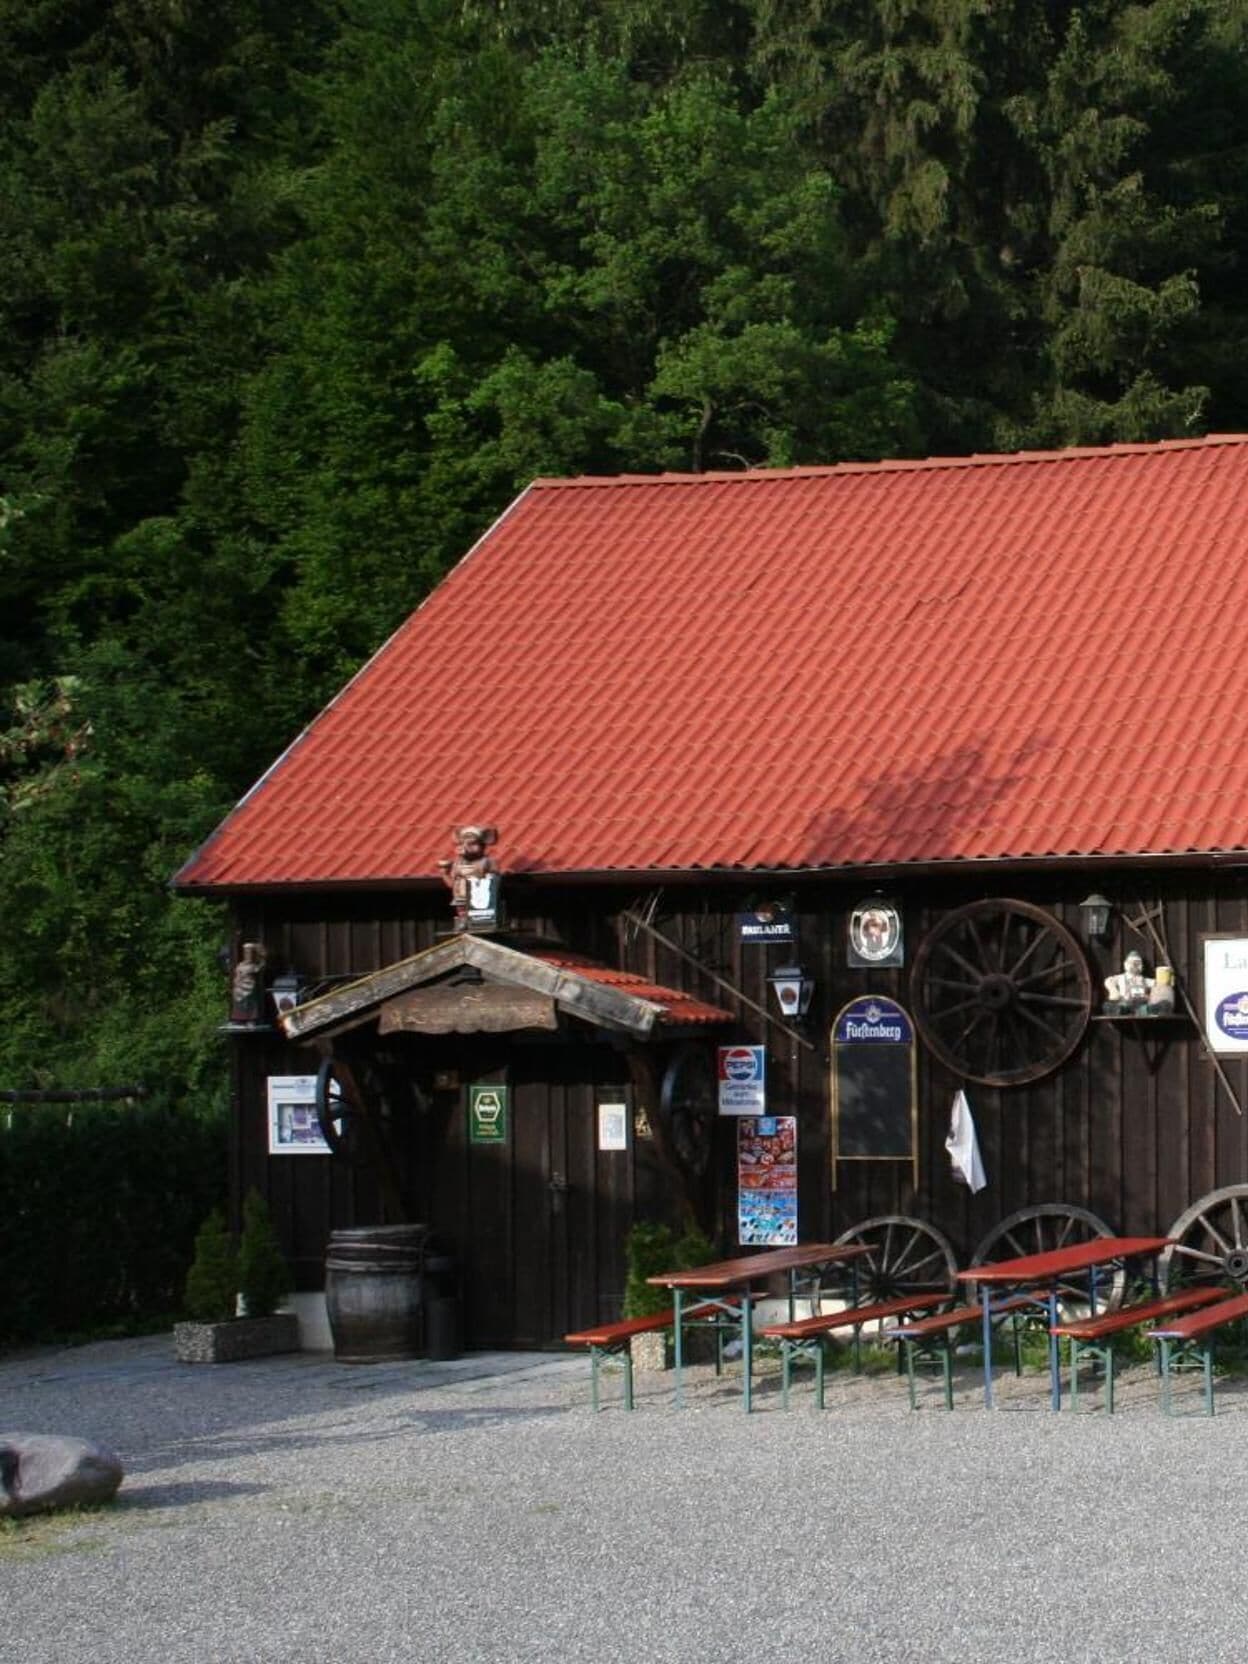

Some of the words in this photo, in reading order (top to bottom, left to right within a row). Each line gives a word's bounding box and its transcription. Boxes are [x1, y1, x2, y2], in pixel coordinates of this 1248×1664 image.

[741, 924, 791, 935] PAULANER
[846, 1021, 901, 1041] Fürstenberg
[726, 1061, 756, 1069] PEPSI
